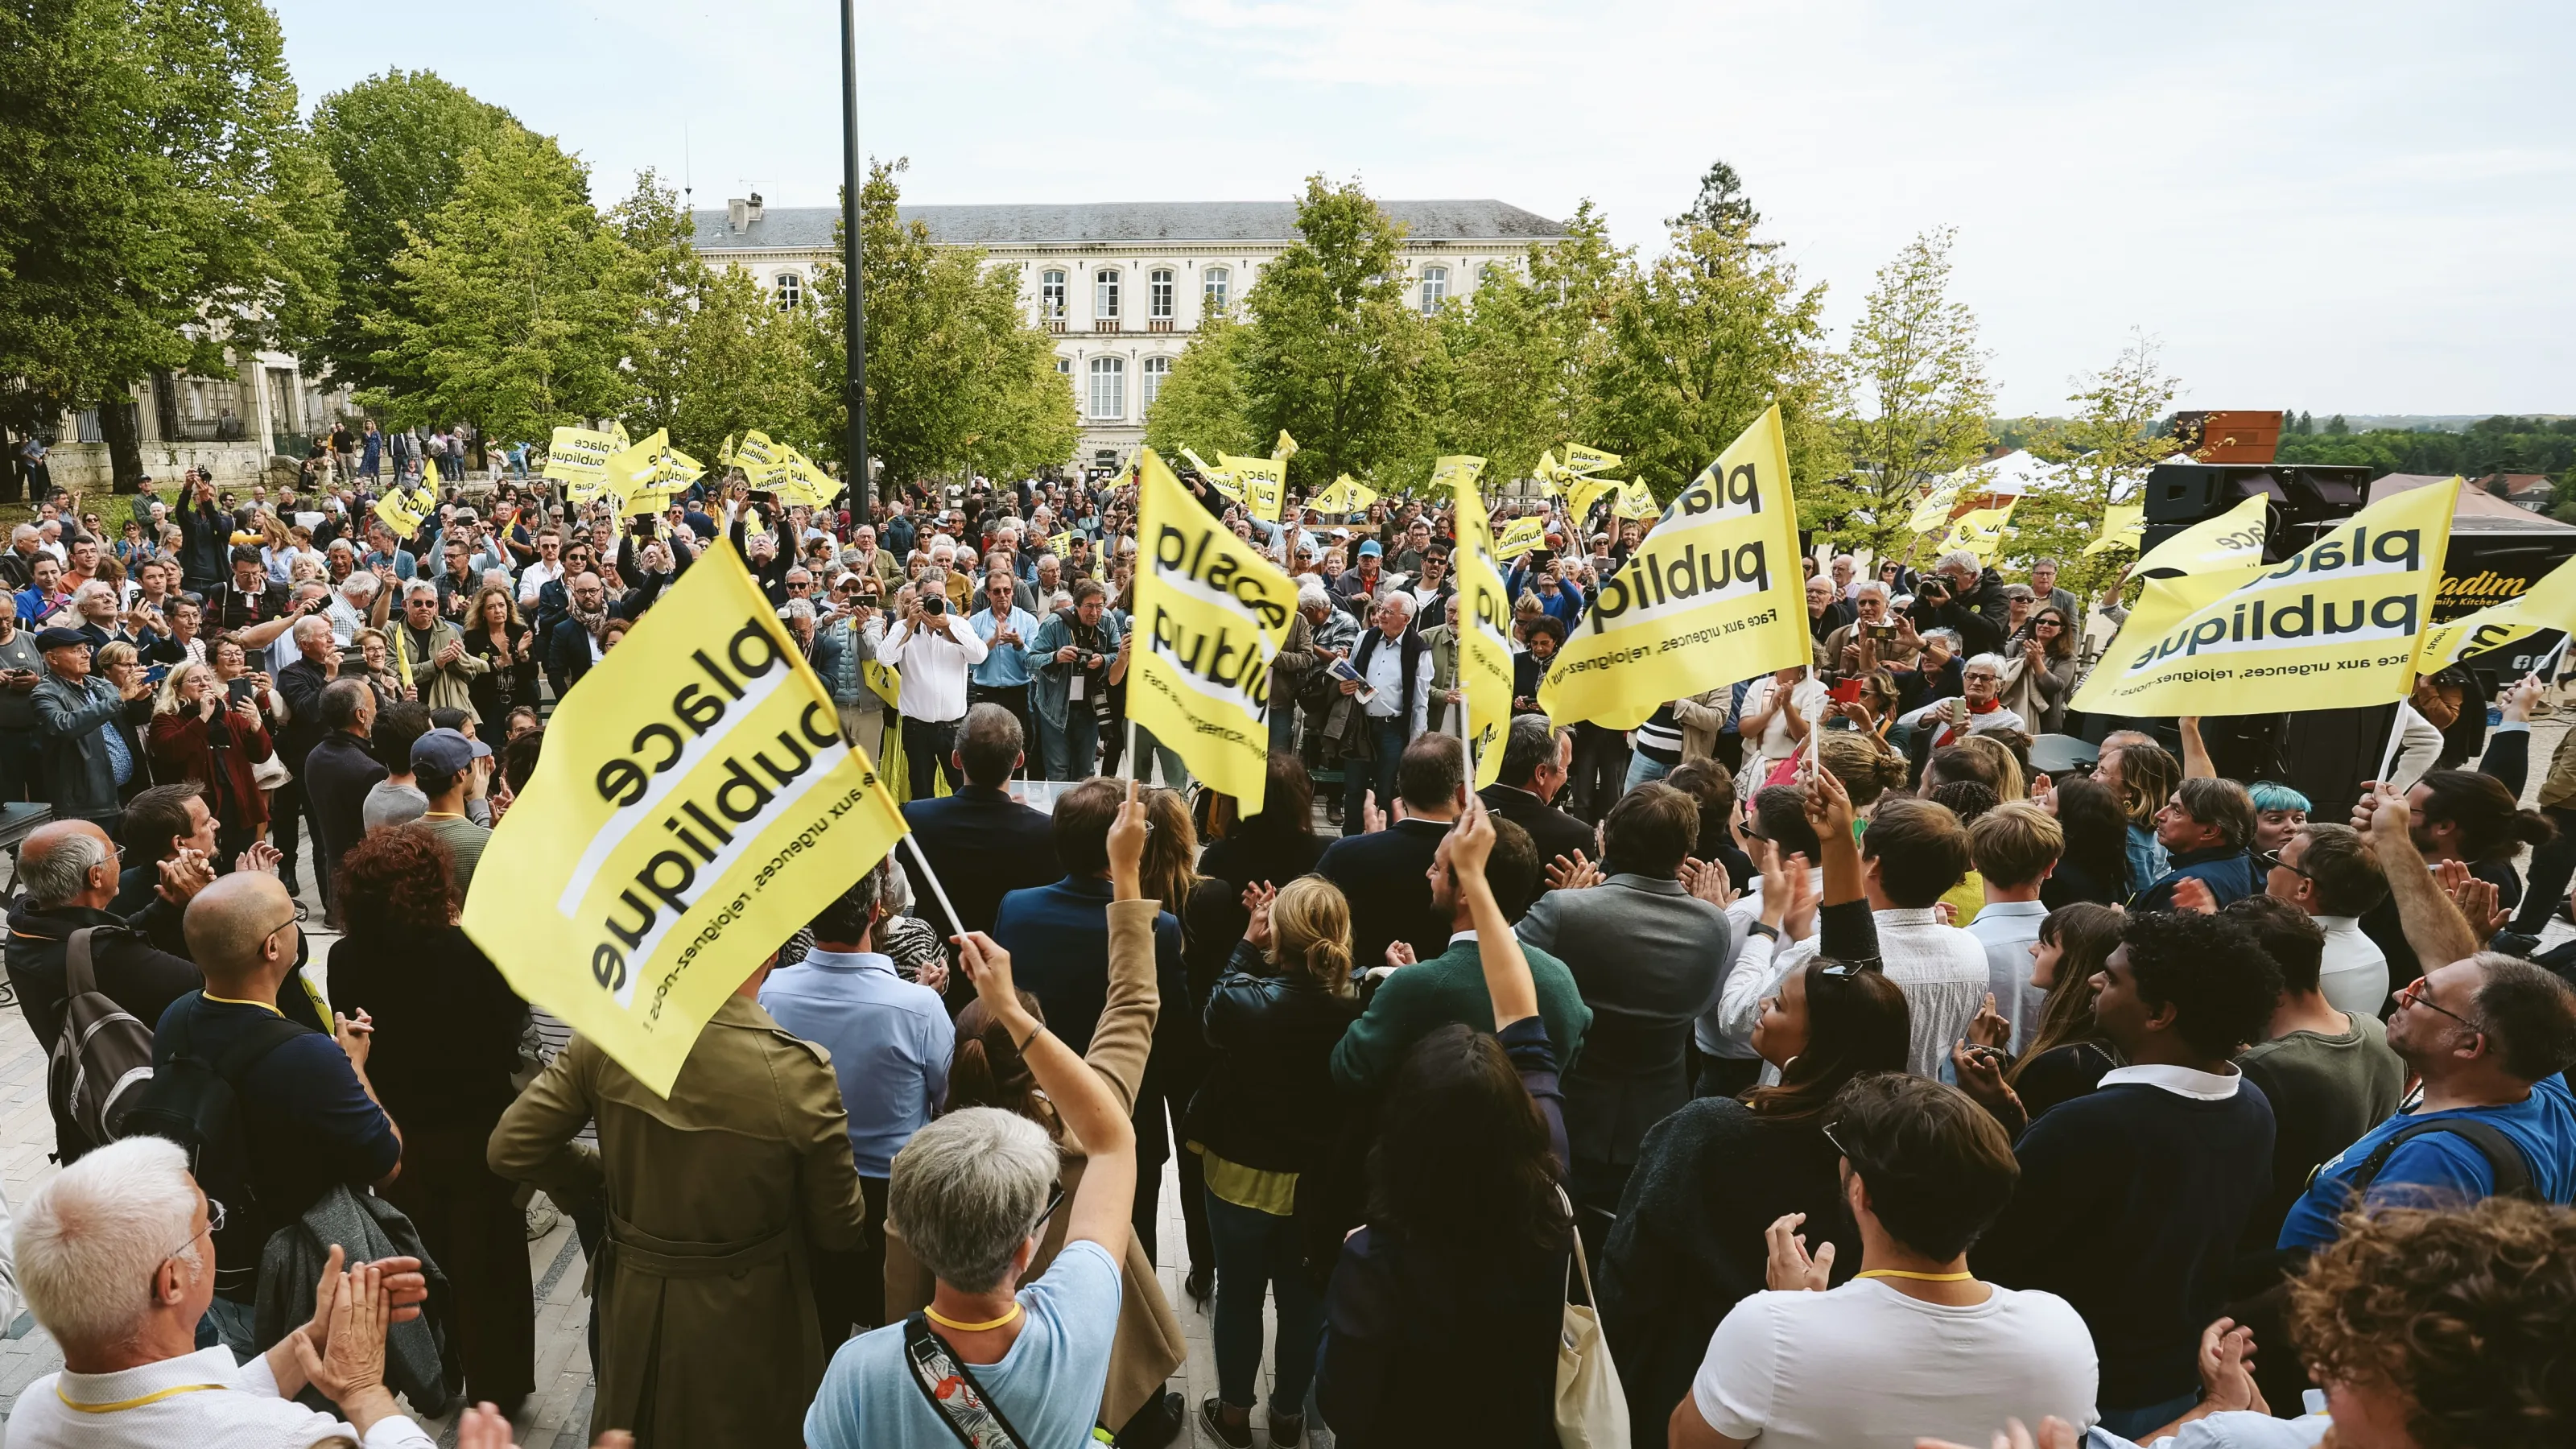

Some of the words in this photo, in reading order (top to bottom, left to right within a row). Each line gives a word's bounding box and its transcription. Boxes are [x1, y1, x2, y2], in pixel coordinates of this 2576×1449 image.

[746, 436, 769, 450] place
[1571, 452, 1602, 461] place
[1058, 537, 1067, 559] plac
[1156, 523, 1286, 630] place
[2436, 569, 2532, 597] adim
[2434, 597, 2456, 607] mily
[2458, 597, 2500, 605] Kitchen
[1152, 604, 1270, 724] publiq
